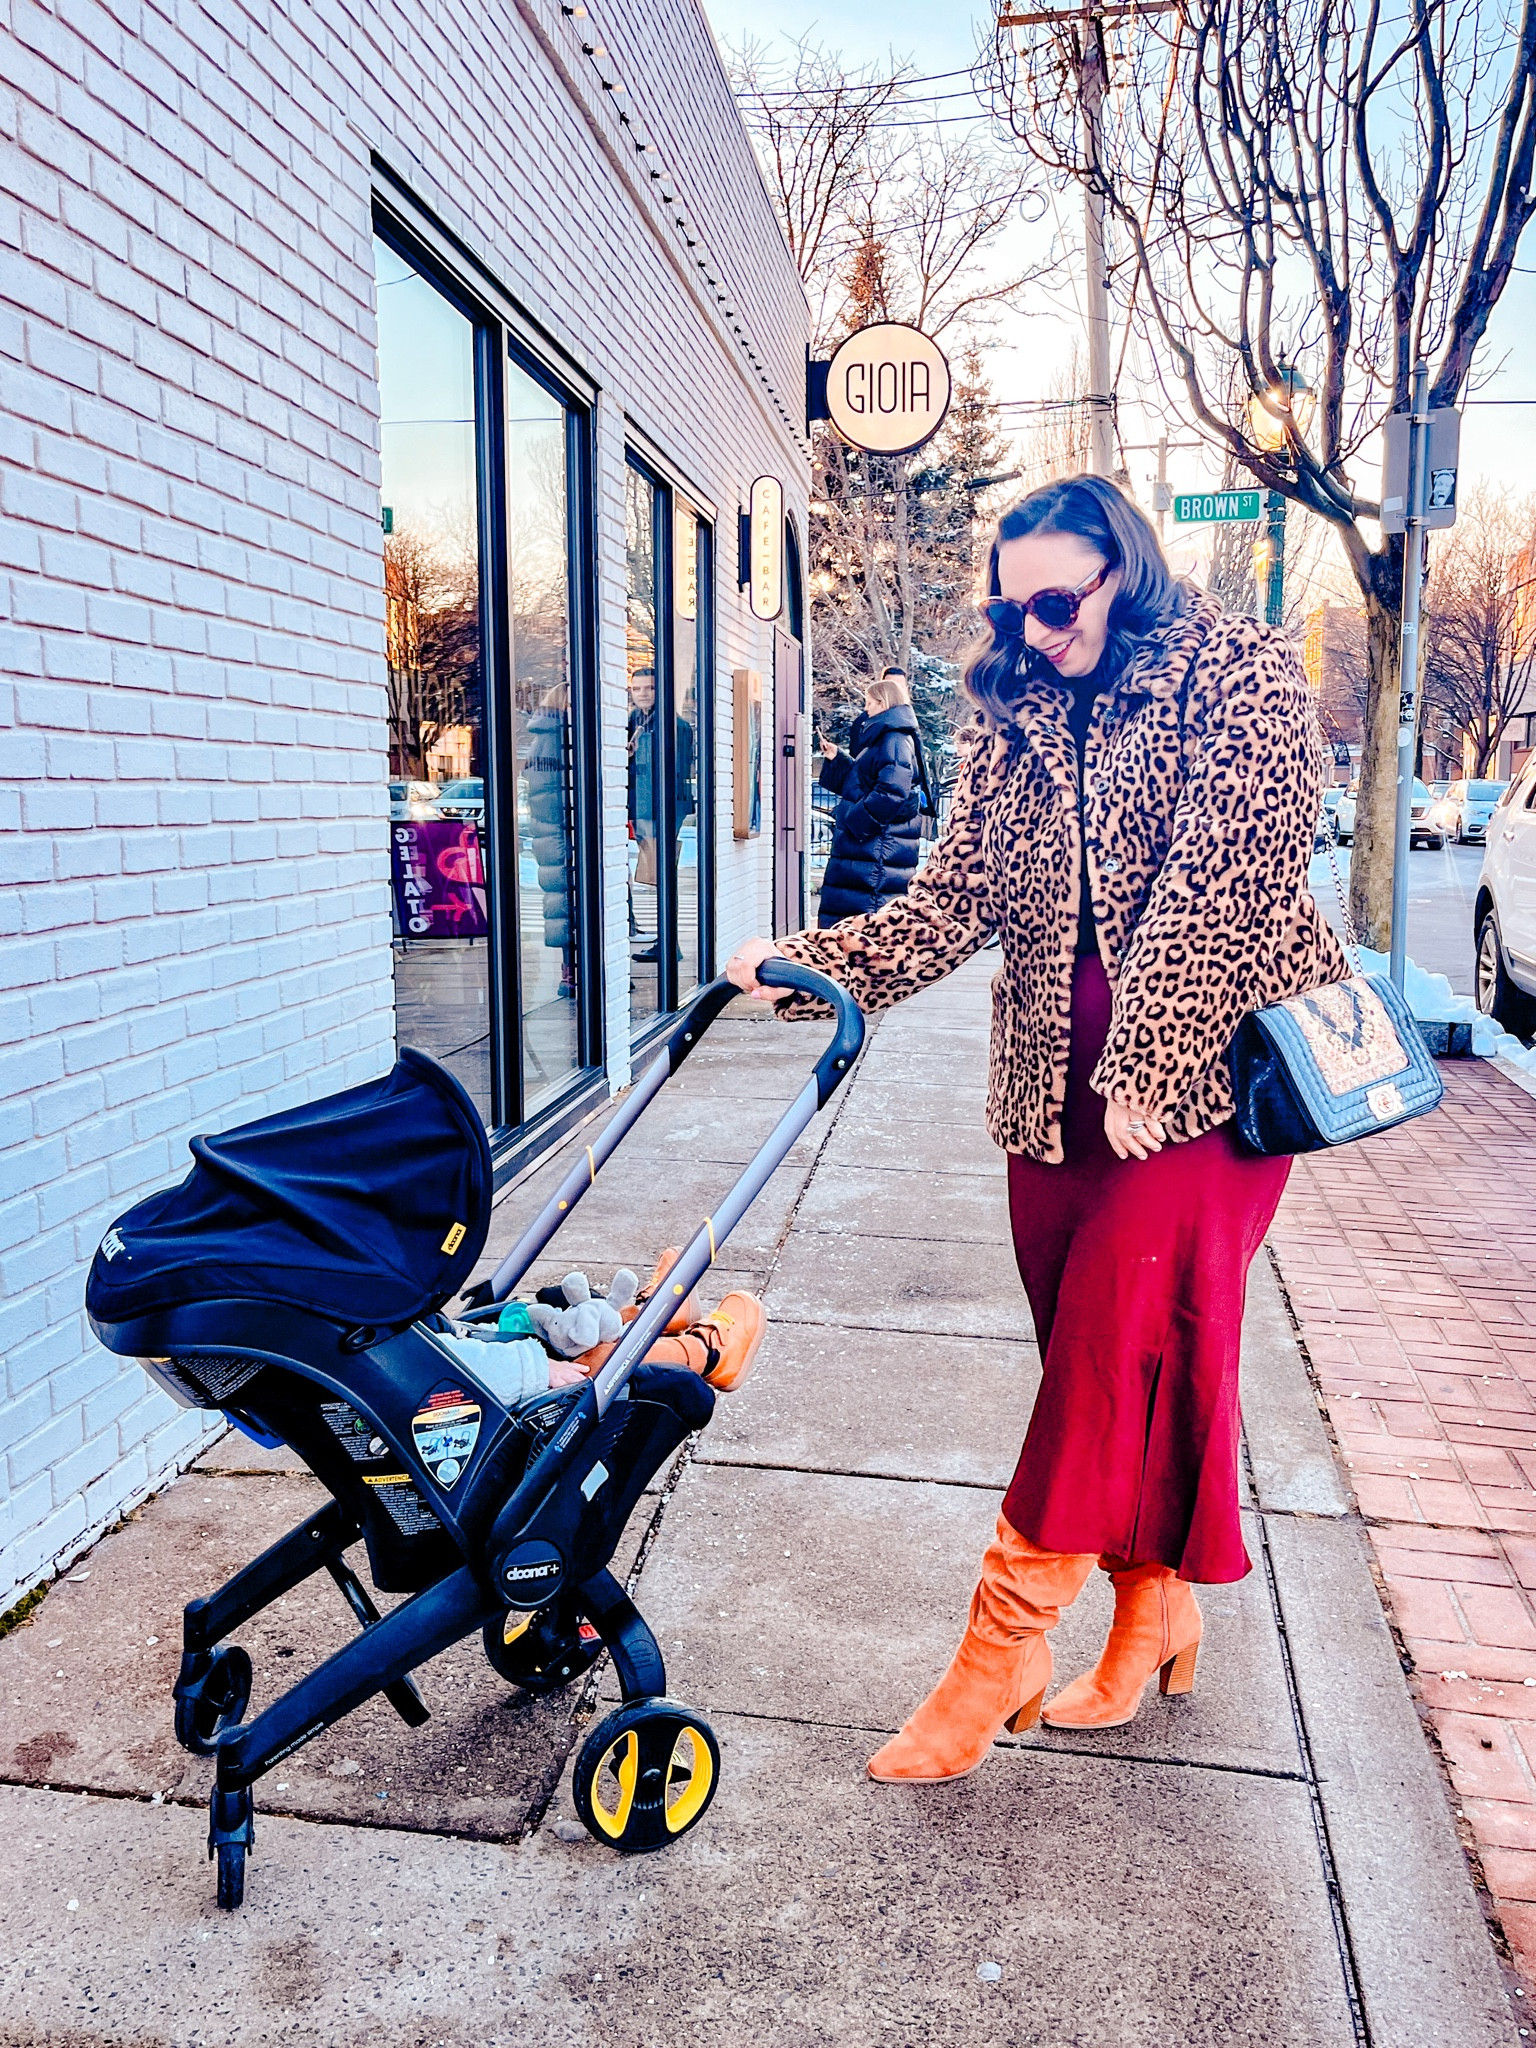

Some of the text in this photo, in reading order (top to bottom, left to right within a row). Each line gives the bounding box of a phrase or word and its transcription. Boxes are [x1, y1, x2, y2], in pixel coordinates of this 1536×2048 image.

[846, 361, 930, 414] GIOIA
[1181, 495, 1253, 519] BROWN ST
[447, 1228, 462, 1251] doona
[374, 1474, 409, 1483] ADVERTENCI
[264, 1721, 324, 1766] Parenting made simple
